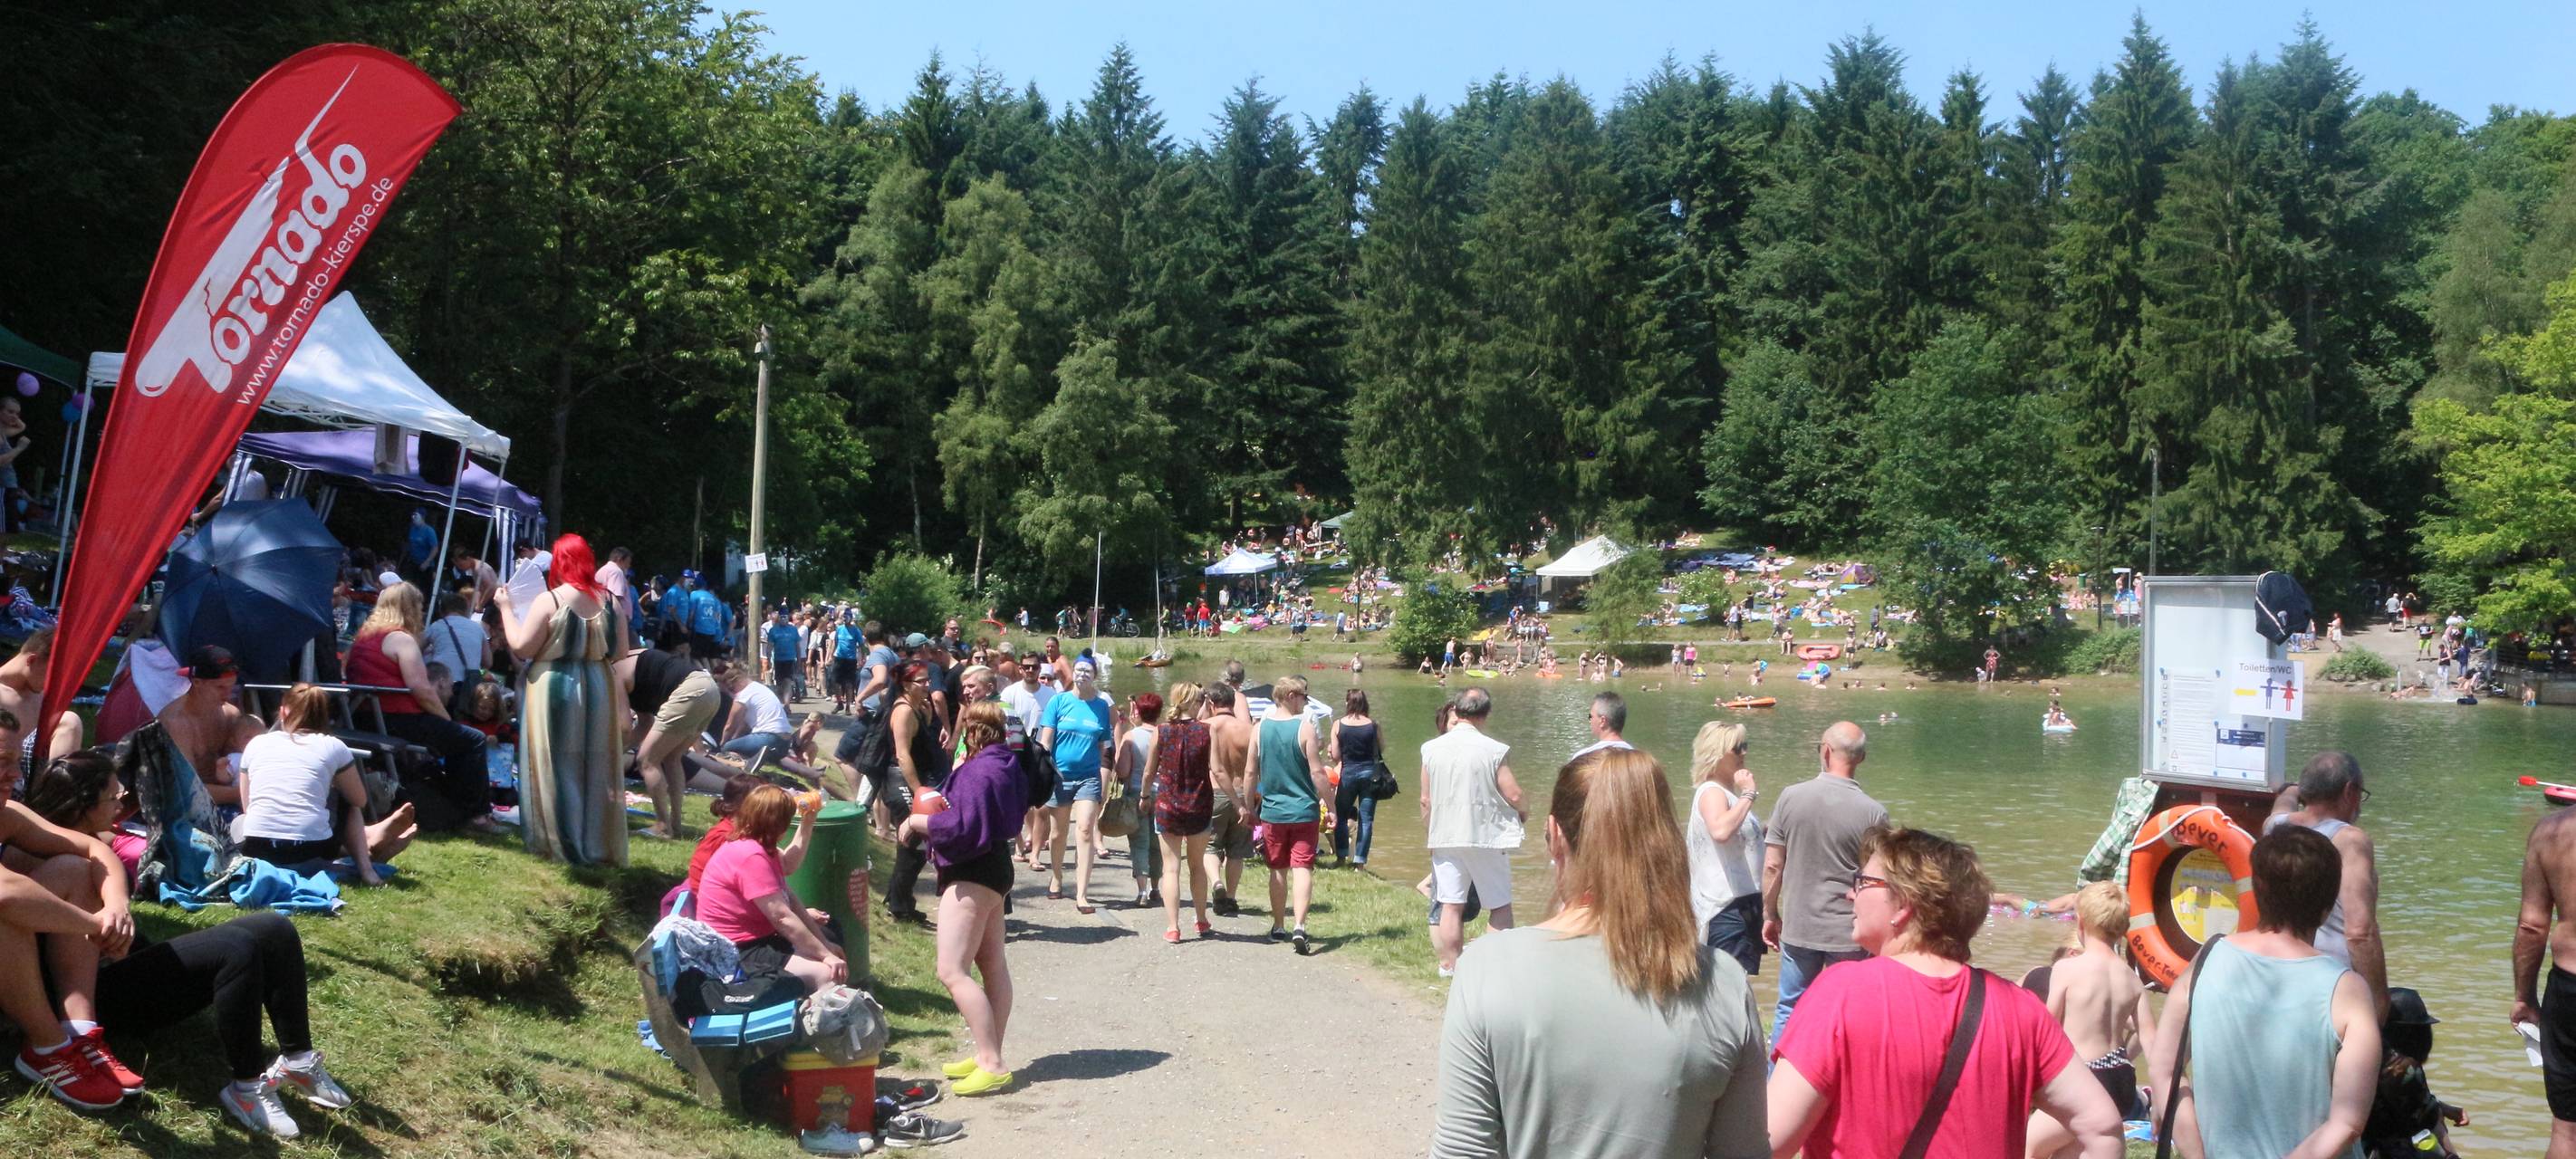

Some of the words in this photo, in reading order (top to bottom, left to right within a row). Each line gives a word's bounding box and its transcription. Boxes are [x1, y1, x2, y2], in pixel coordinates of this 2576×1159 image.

[135, 63, 367, 398] Tornado
[237, 177, 393, 406] www.tornado-kierspe.de
[2238, 662, 2292, 675] Toiletten/WC
